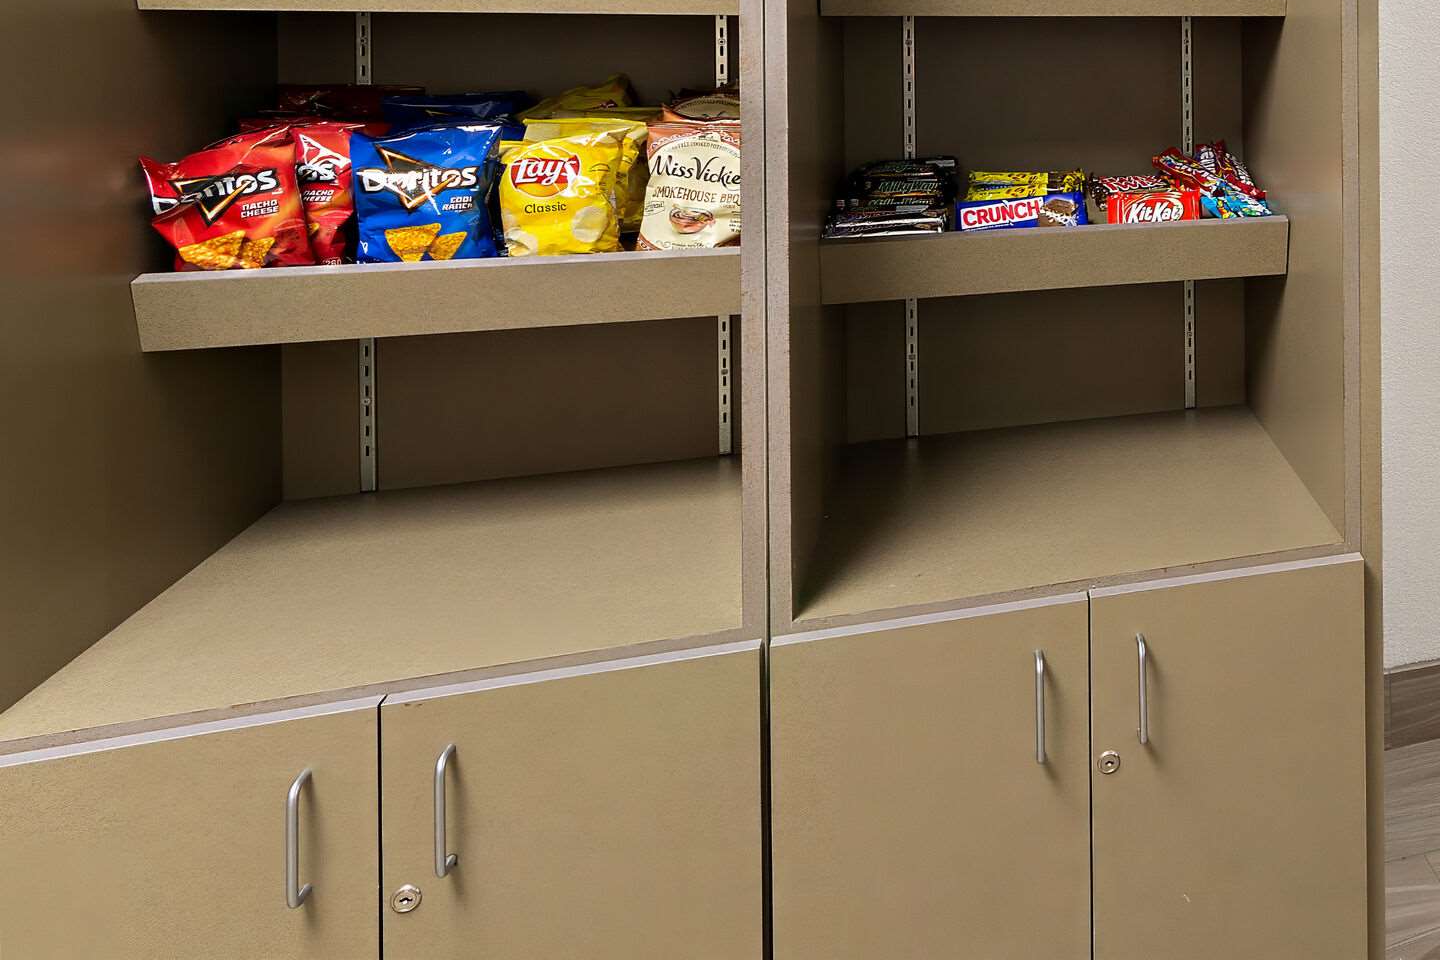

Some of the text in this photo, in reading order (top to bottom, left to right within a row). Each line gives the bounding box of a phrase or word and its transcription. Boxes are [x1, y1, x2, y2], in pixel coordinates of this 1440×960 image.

[650, 155, 741, 188] Miss Vickie
[652, 186, 718, 204] SMOKEHOUSE
[240, 206, 280, 218] CHEESE
[242, 199, 279, 211] NACHO
[524, 202, 567, 214] Classic
[963, 199, 1040, 227] CRUNCH
